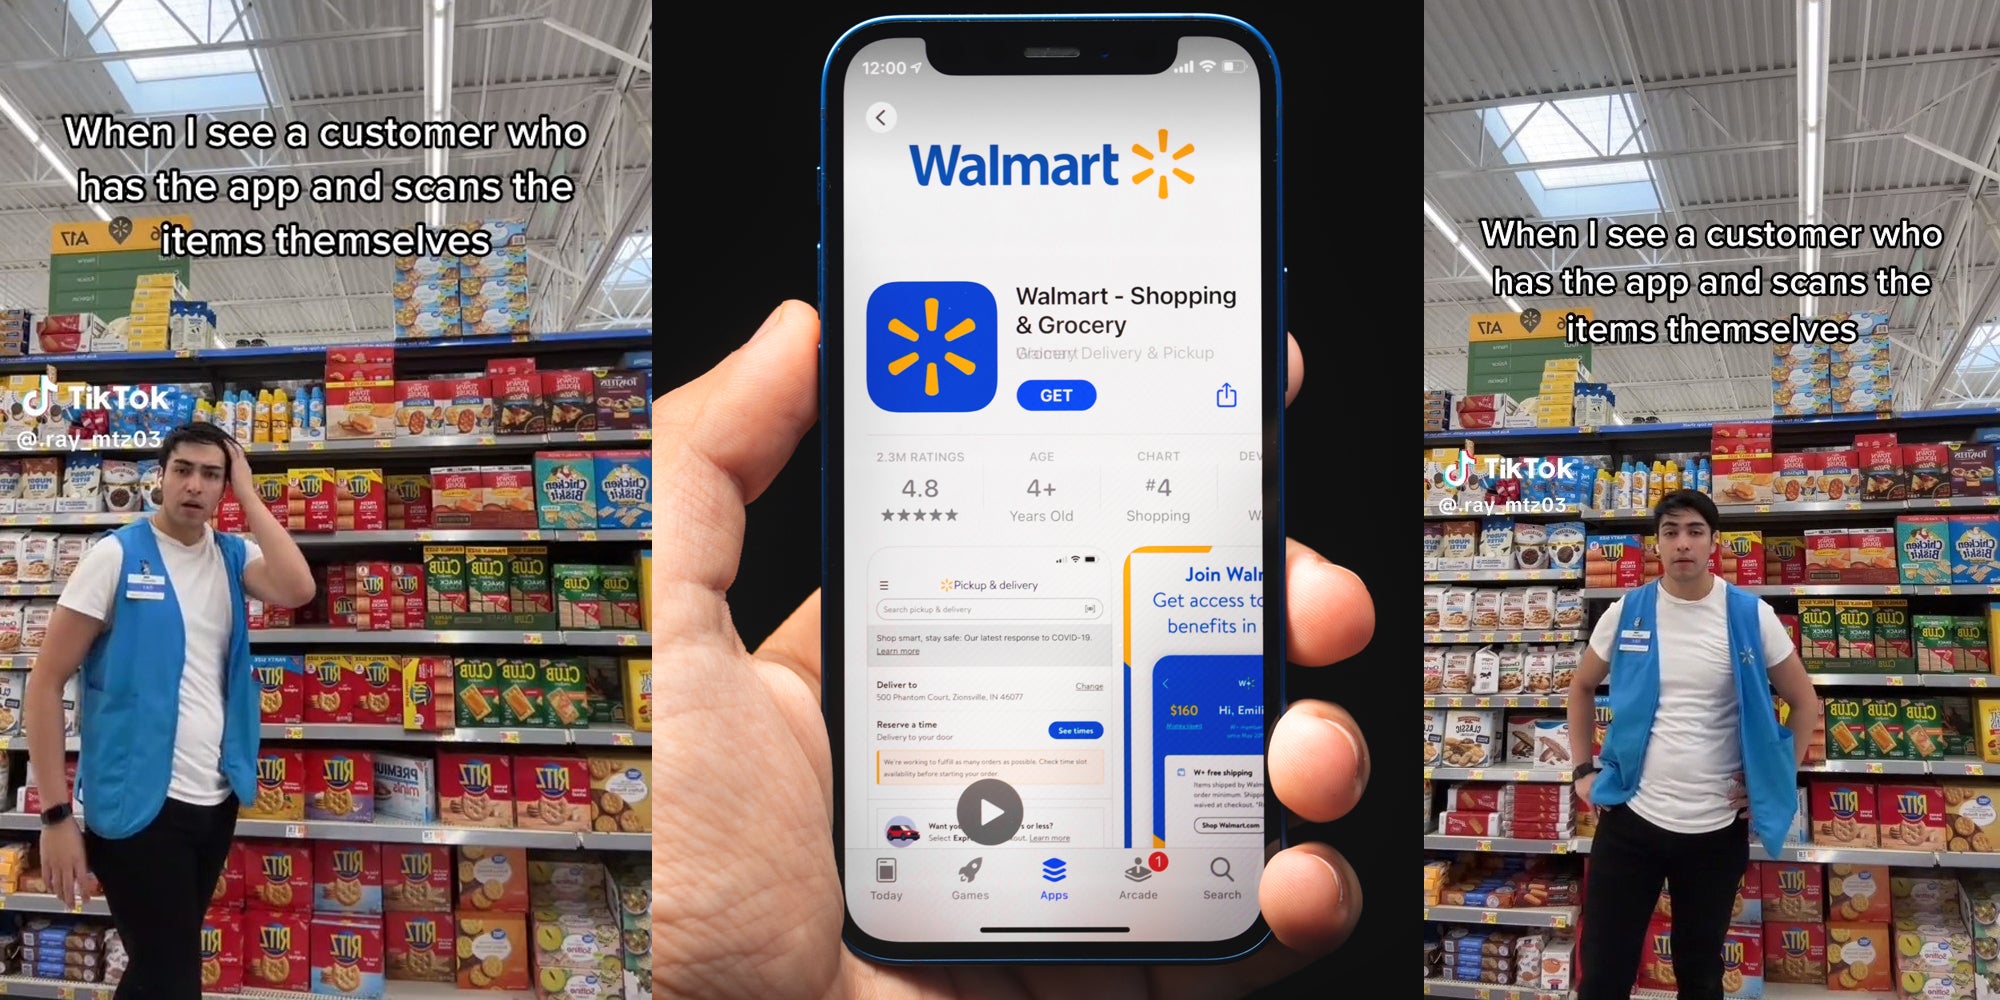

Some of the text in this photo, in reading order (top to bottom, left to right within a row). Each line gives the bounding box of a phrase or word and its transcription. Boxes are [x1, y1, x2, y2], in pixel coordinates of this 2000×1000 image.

[863, 62, 906, 75] 12:00
[909, 144, 1119, 186] Walmart
[1016, 287, 1108, 305] Walmart
[1131, 286, 1236, 308] Shopping
[1016, 316, 1126, 338] & Grocery
[1082, 346, 1142, 362] Delivery
[1148, 346, 1158, 359] &
[1164, 346, 1214, 362] Pickup
[1041, 389, 1073, 402] GET
[877, 452, 964, 462] 2.3M RATINGS
[1030, 452, 1054, 461] AGE
[1137, 451, 1180, 461] CHART
[902, 479, 938, 497] 4.8
[1027, 479, 1056, 497] 4+
[1146, 479, 1172, 496] #4
[1010, 510, 1073, 521] Years Old
[1127, 510, 1190, 524] Shopping
[1186, 567, 1220, 582] Join
[954, 580, 1038, 592] Pickup & delivery
[1153, 592, 1184, 608] Get
[1190, 597, 1244, 608] access
[910, 606, 934, 614] pickup
[943, 606, 971, 614] delivery
[1168, 618, 1256, 633] benefits in
[877, 635, 896, 643] Shop
[876, 647, 920, 656] Learn more
[1076, 682, 1104, 691] Change
[1170, 704, 1198, 716] $160
[1219, 706, 1234, 716] Hi,
[877, 733, 907, 741] Delivery
[1155, 856, 1161, 867] 1
[870, 891, 902, 902] Today
[952, 891, 989, 900] Games
[1041, 891, 1068, 901] Apps
[1119, 890, 1158, 899] Arcade
[1204, 890, 1241, 899] Search
